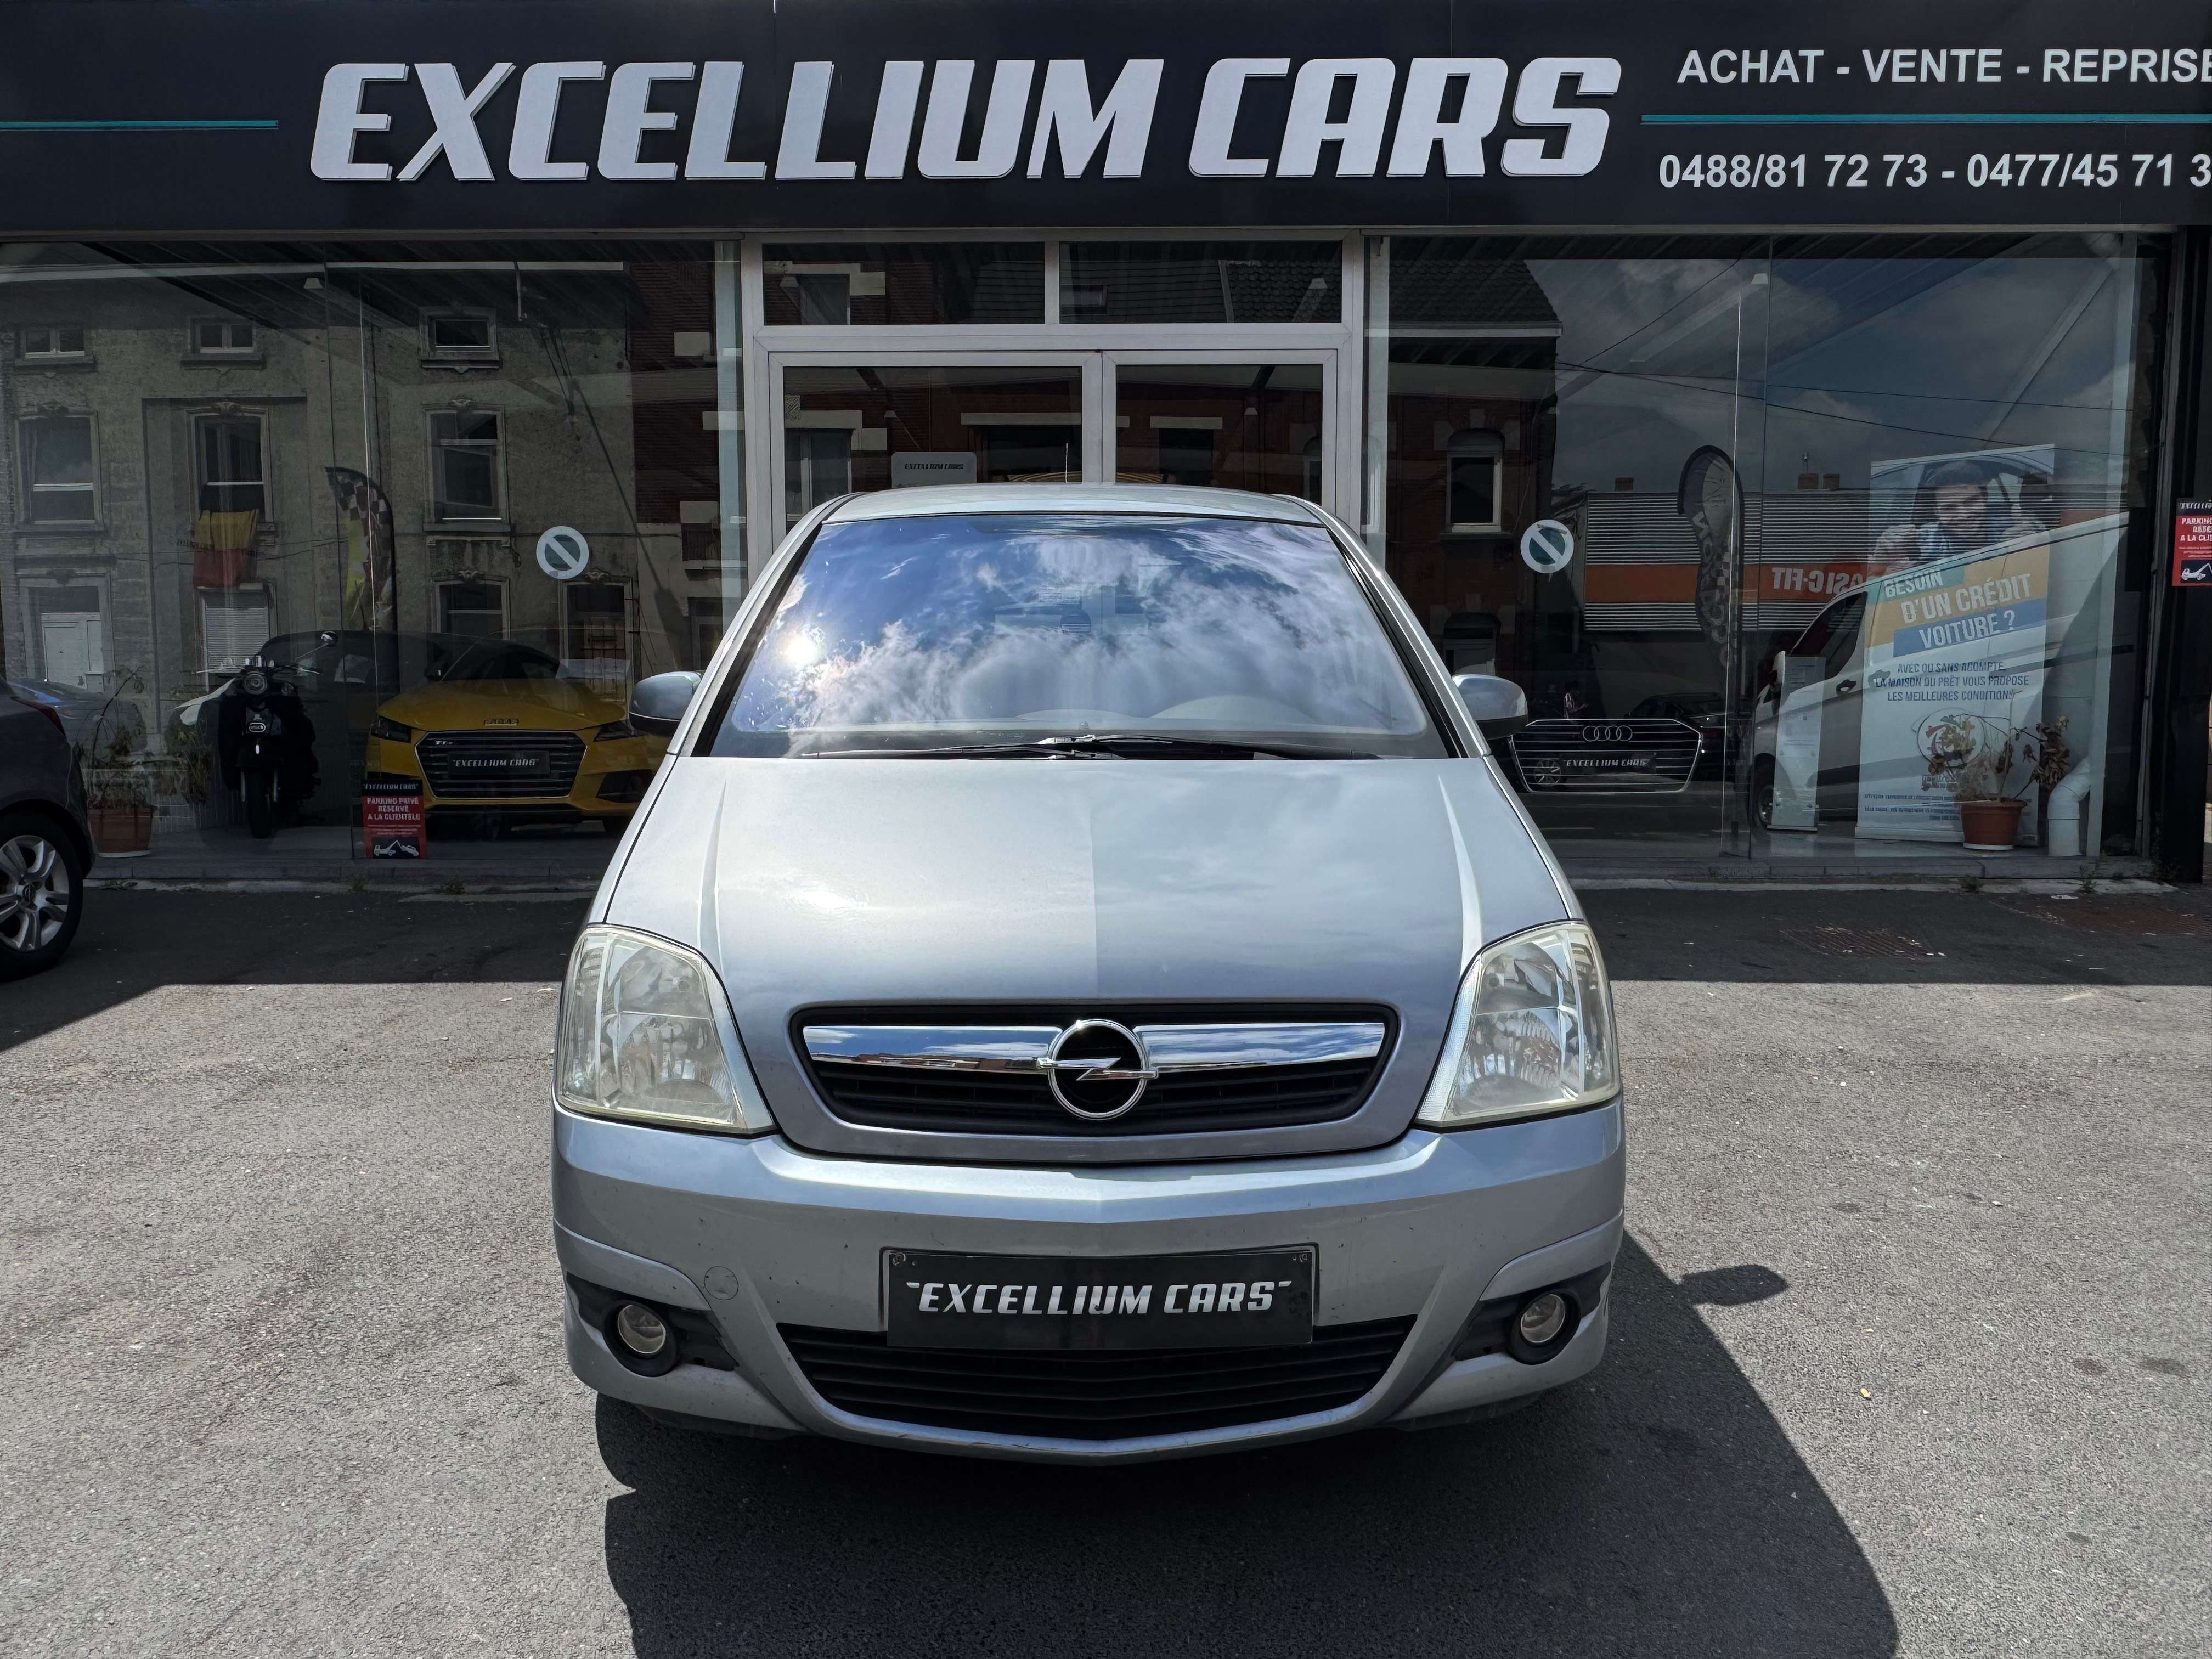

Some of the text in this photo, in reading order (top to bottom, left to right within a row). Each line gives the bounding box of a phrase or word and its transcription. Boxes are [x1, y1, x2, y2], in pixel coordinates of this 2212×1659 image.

[1677, 49, 1824, 84] ACHAT
[1862, 49, 2002, 83] VENTE
[311, 57, 1621, 182] EXCELLIUM CARS
[1659, 154, 1806, 188] 0488/81
[1824, 154, 1868, 188] 72
[1883, 154, 1927, 188] 73
[1967, 153, 2118, 188] 0477/45
[2132, 154, 2172, 187] 71
[2190, 153, 2212, 187] 3
[1884, 568, 1944, 599] BESOIN
[1900, 573, 2031, 624] D'UN CRÉDIT
[1918, 613, 2002, 649] VOITURE
[1888, 677, 1922, 687] MAISON
[1924, 676, 1936, 686] DU
[1938, 675, 1960, 686] PRÊT
[1963, 676, 1986, 686] VOUS
[1988, 675, 2029, 685] PROPOSE
[1897, 663, 1920, 673] AVEC
[1922, 663, 1933, 673] OU
[1935, 662, 1959, 673] SANS
[1888, 691, 1903, 701] LES
[1905, 690, 1959, 701] MEILLEURES
[919, 1281, 1275, 1315] EXCELLIUM CARS
